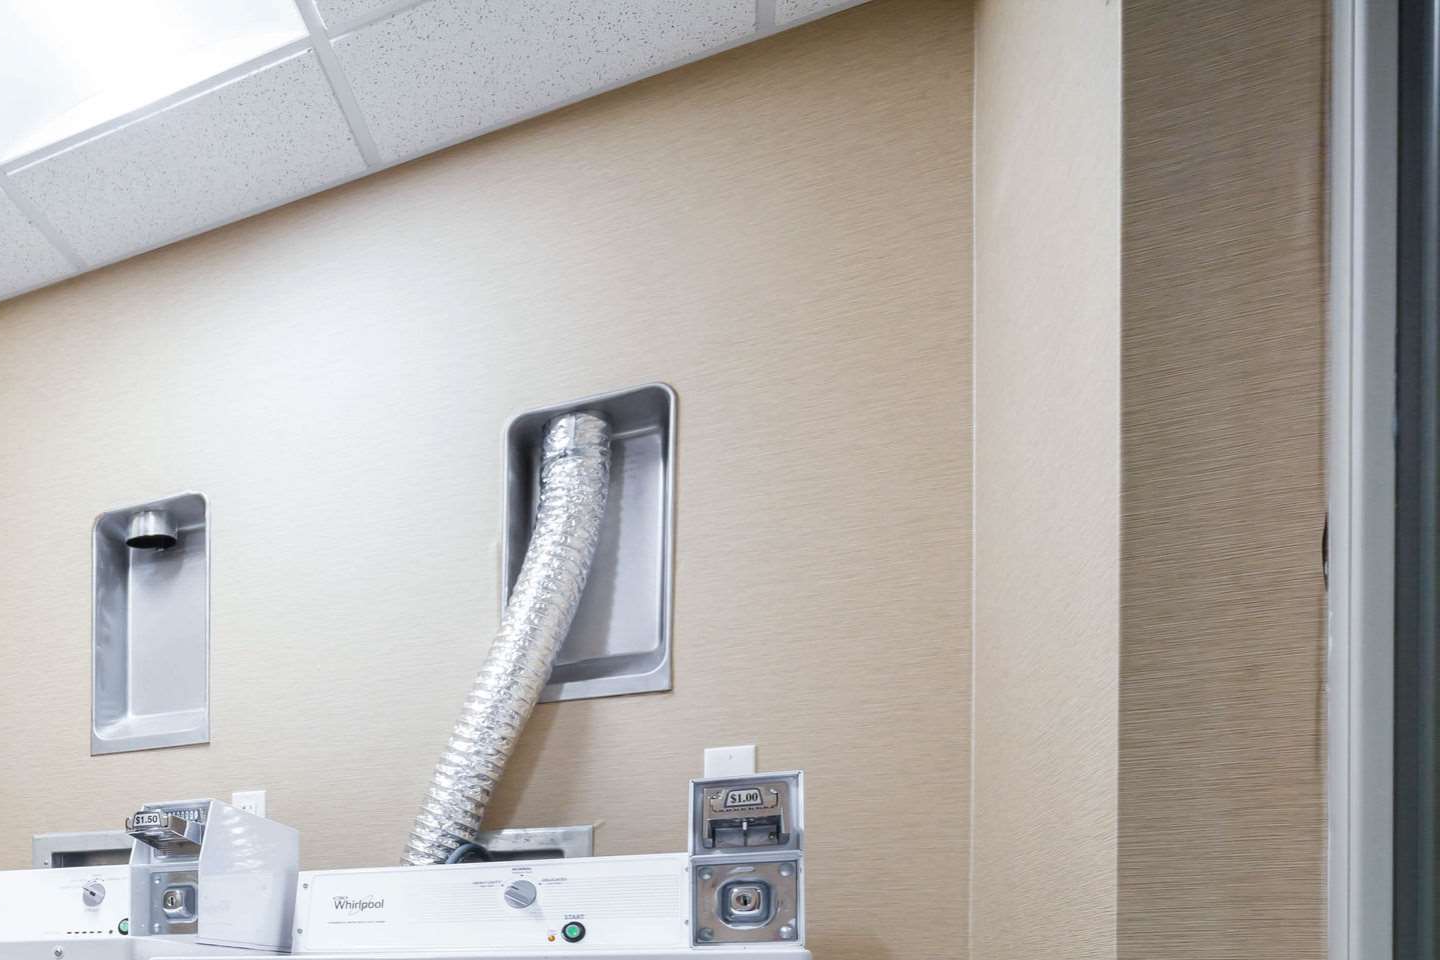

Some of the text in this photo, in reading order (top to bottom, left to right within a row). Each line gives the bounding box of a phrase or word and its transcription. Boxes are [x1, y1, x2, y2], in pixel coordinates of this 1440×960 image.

[729, 792, 758, 803] $1.00
[135, 815, 158, 825] $1.50
[334, 898, 384, 912] Whirlpool
